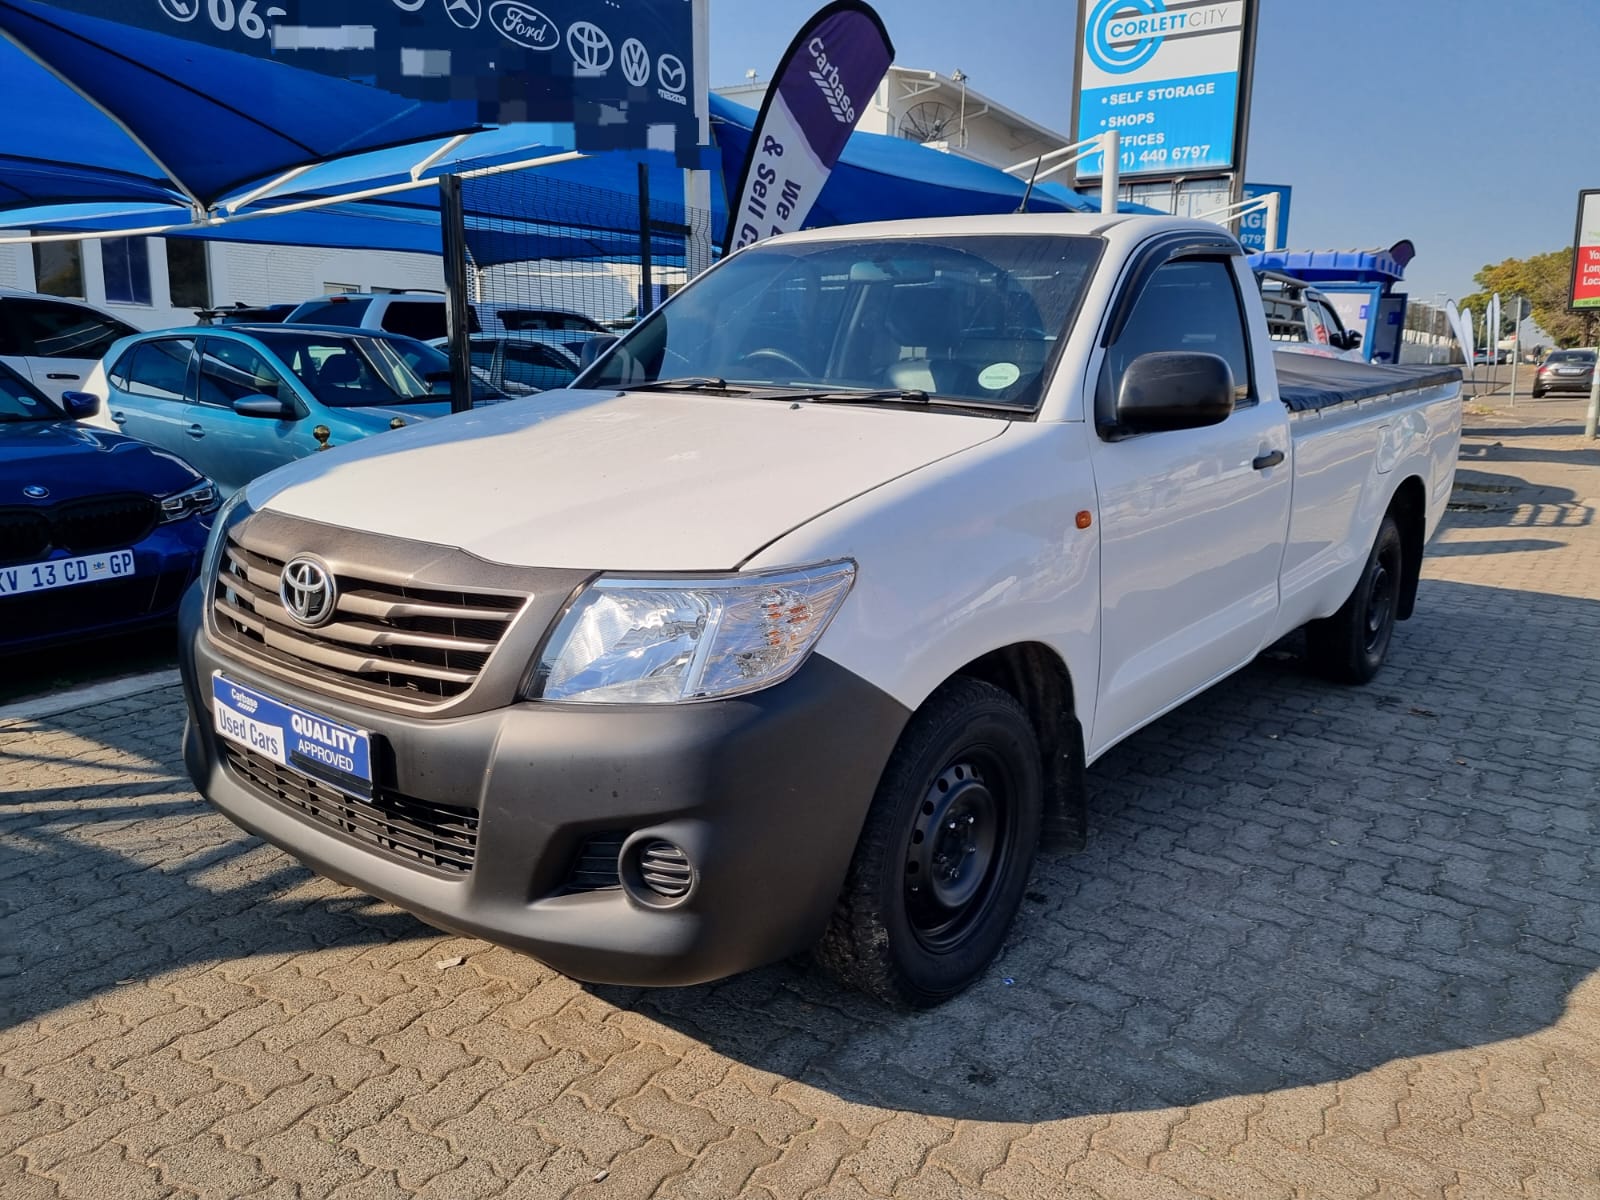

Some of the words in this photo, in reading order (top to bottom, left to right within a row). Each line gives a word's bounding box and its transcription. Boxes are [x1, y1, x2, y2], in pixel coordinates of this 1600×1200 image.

[502, 7, 547, 42] Ford
[658, 88, 686, 105] mazda
[808, 37, 855, 123] Carbase
[1110, 91, 1143, 105] SELF
[1147, 82, 1215, 101] STORAGE
[1108, 112, 1155, 128] SHOPS
[762, 135, 784, 157] &
[1119, 133, 1165, 147] FFICES
[1139, 148, 1168, 163] 440
[1172, 144, 1211, 160] 6797
[748, 163, 776, 220] Sell
[777, 179, 801, 220] We
[31, 565, 57, 588] 13
[64, 560, 88, 582] CD
[110, 553, 131, 574] GP
[218, 707, 247, 739] Used
[250, 723, 278, 755] Cars
[291, 714, 357, 754] QUALITY
[298, 739, 354, 772] APPROVED
